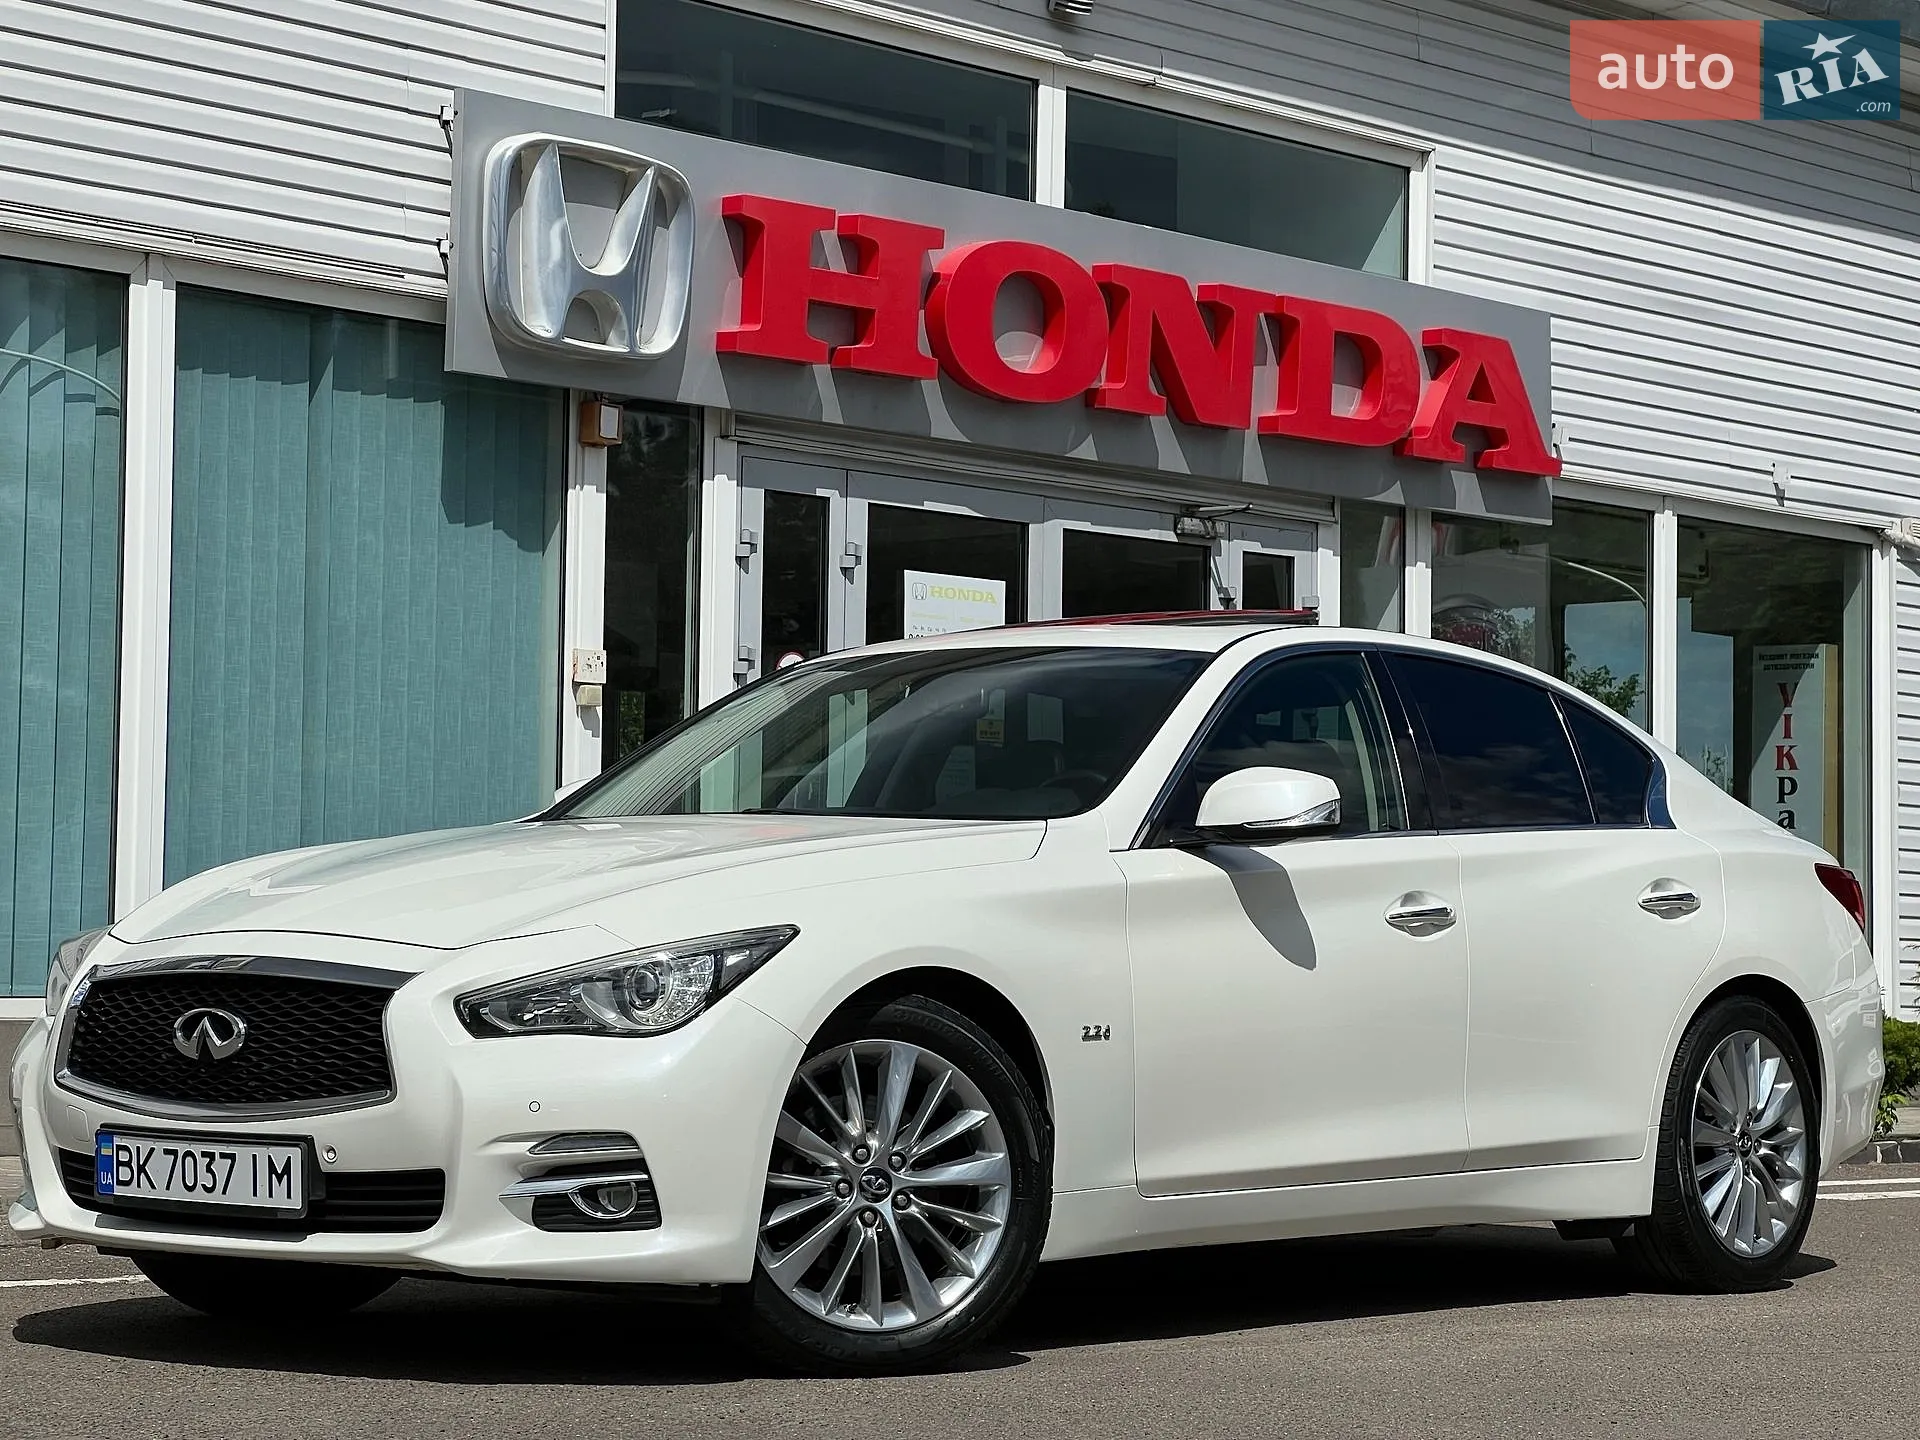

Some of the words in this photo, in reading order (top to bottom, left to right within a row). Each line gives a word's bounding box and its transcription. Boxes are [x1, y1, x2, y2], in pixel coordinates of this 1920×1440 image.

[716, 193, 1562, 478] HONDA
[929, 585, 997, 604] HONDA
[101, 1171, 113, 1185] UA
[115, 1144, 157, 1190] BK
[163, 1148, 237, 1196] 7037
[252, 1153, 292, 1199] IM
